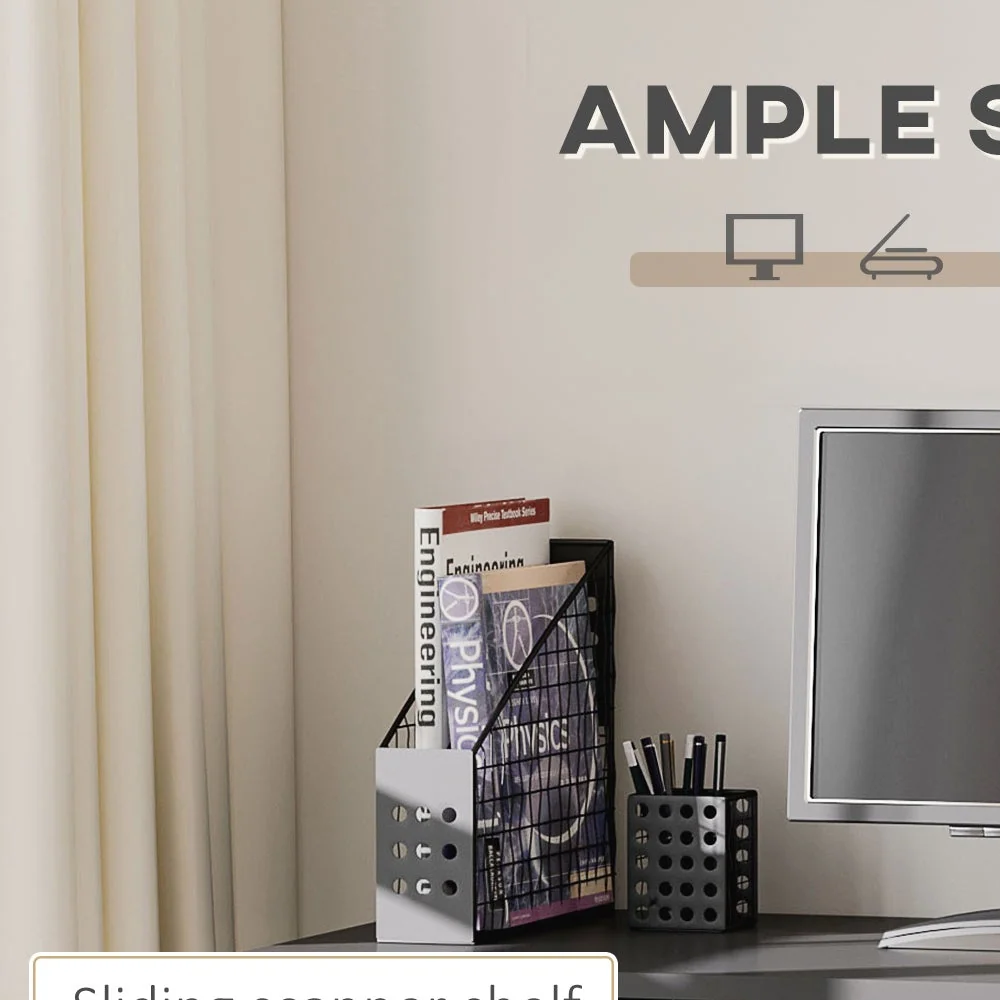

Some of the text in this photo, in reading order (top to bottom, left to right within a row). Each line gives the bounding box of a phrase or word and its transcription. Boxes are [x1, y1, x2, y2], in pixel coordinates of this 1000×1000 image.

[522, 506, 536, 517] Series
[417, 527, 440, 727] Engineering
[447, 638, 484, 768] Physic
